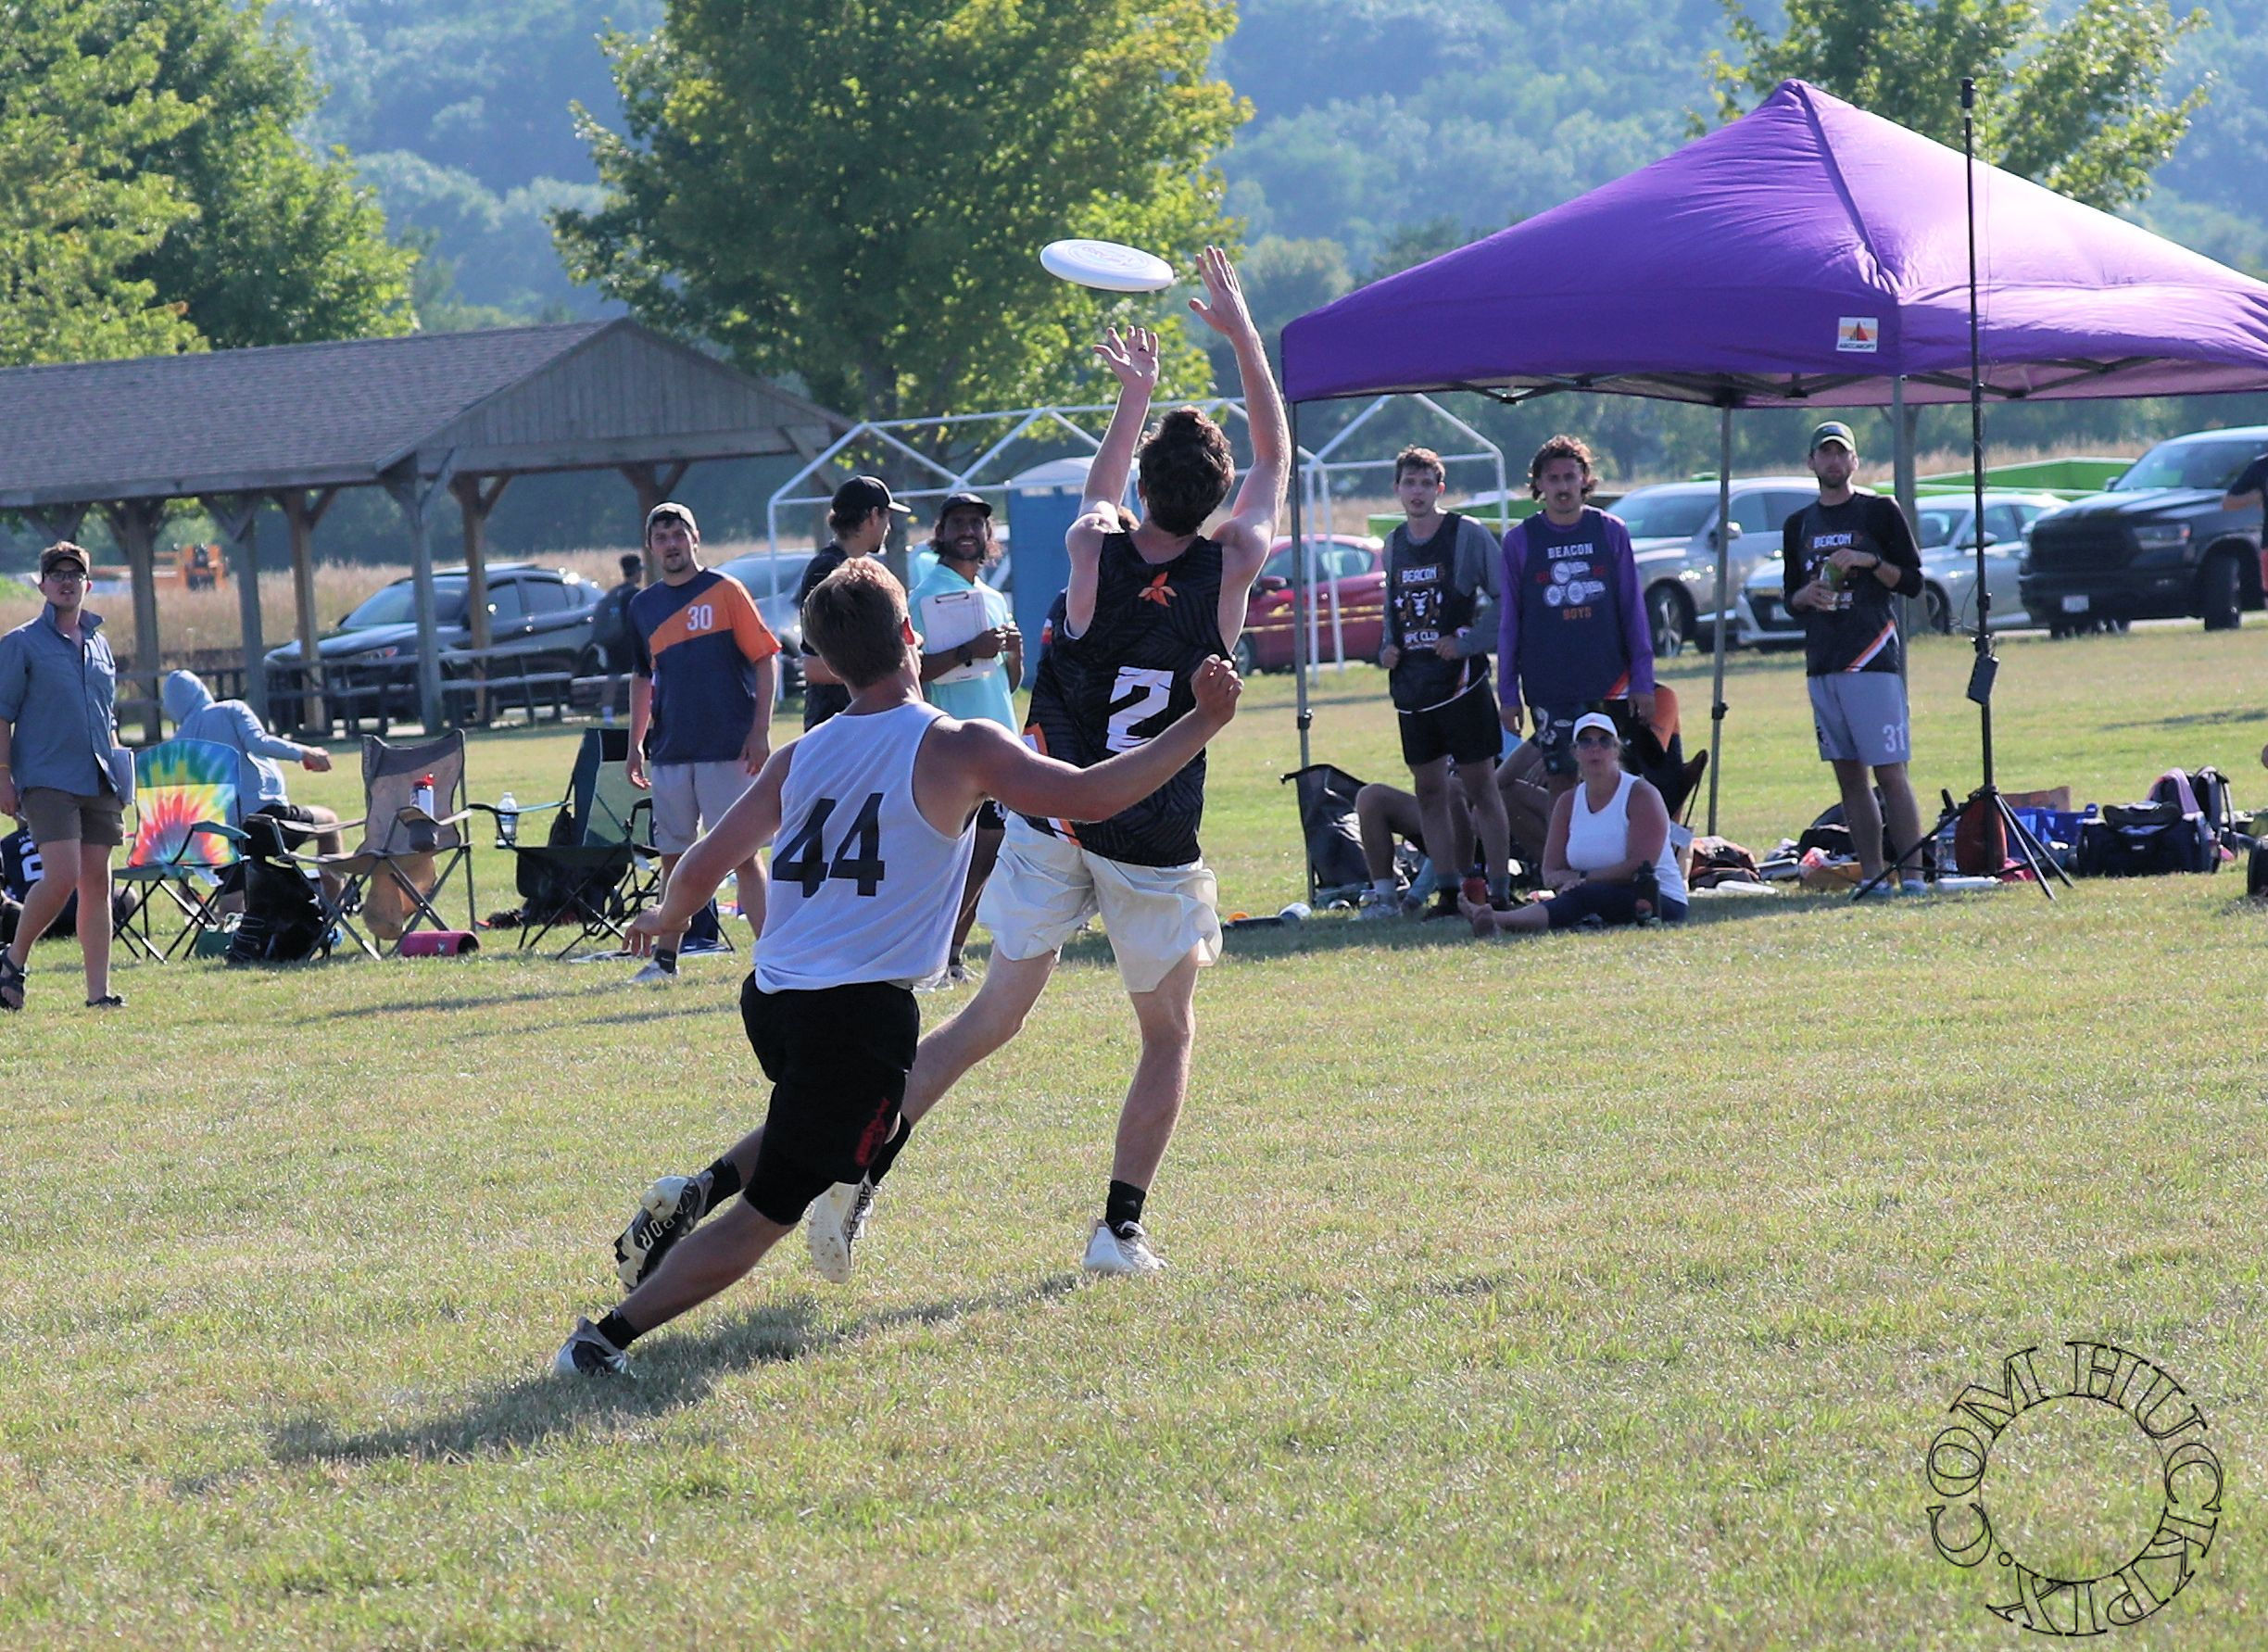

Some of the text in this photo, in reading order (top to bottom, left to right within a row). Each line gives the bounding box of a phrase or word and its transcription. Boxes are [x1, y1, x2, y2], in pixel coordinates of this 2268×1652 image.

[1547, 542, 1594, 560] BEACON
[687, 603, 712, 631] 30
[1104, 665, 1176, 754] 2
[1883, 723, 1906, 753] 31
[772, 791, 886, 898] 44
